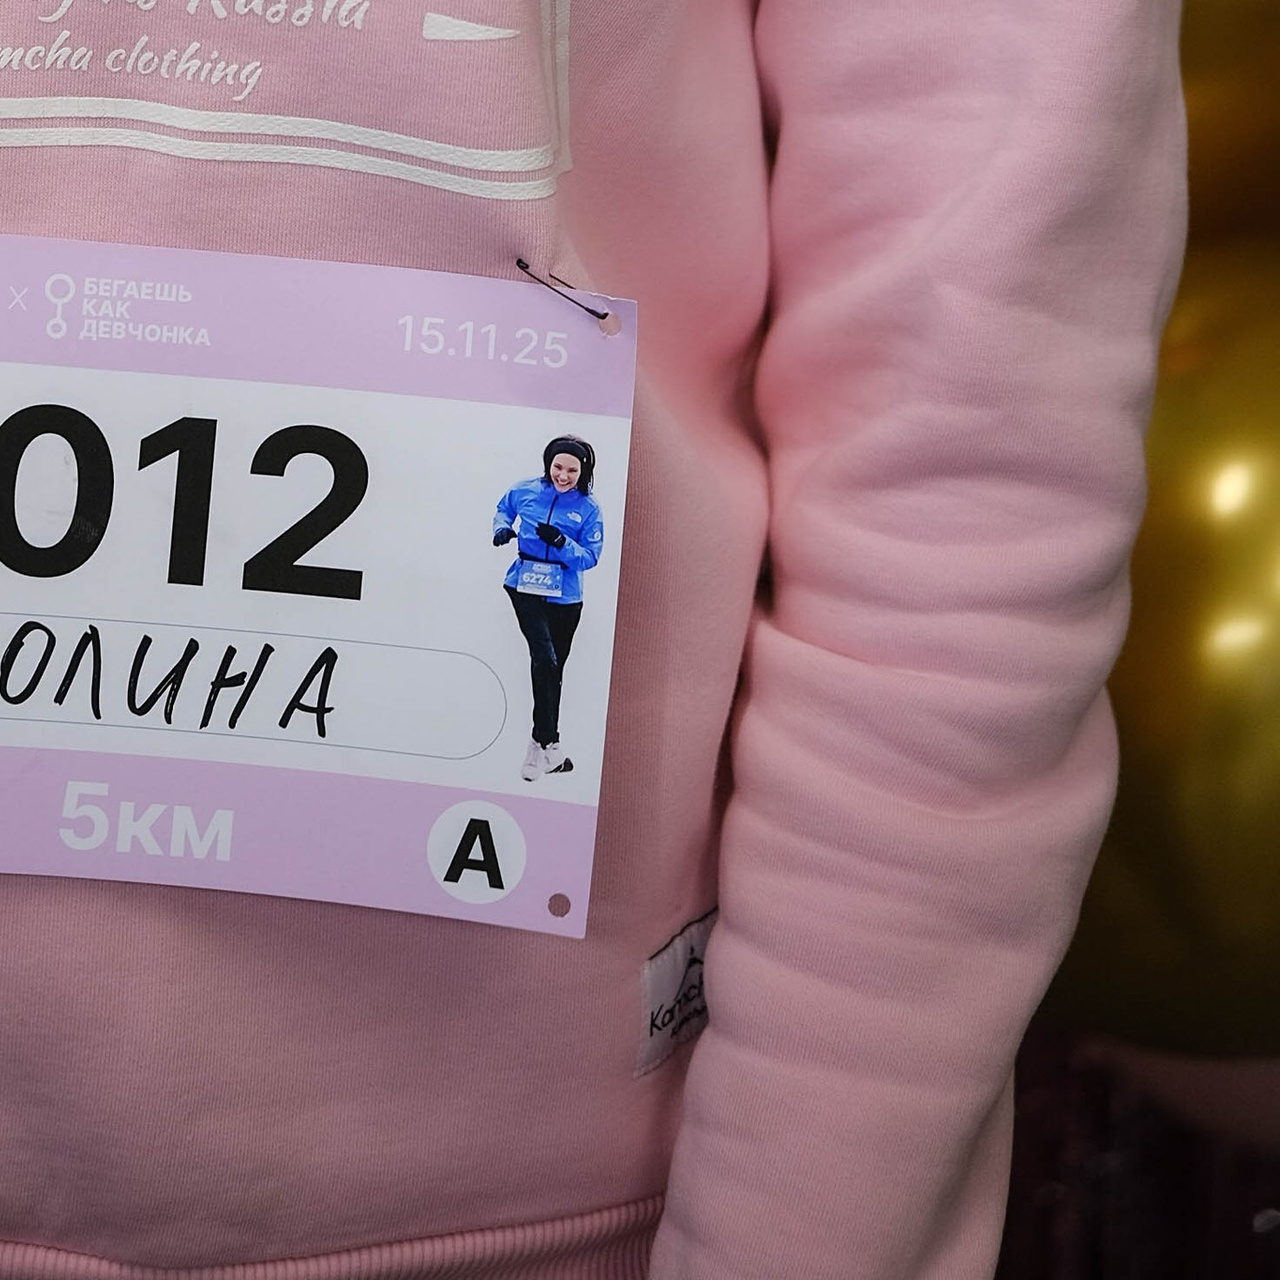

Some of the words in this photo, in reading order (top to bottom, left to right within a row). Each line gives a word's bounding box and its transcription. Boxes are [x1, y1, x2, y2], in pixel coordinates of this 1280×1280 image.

[105, 35, 263, 101] clothing
[83, 278, 193, 303] БЕГАЕШЬ
[81, 298, 131, 319] КАК
[78, 319, 212, 346] ДЕВЧОНКА
[398, 315, 568, 368] 15.11.25
